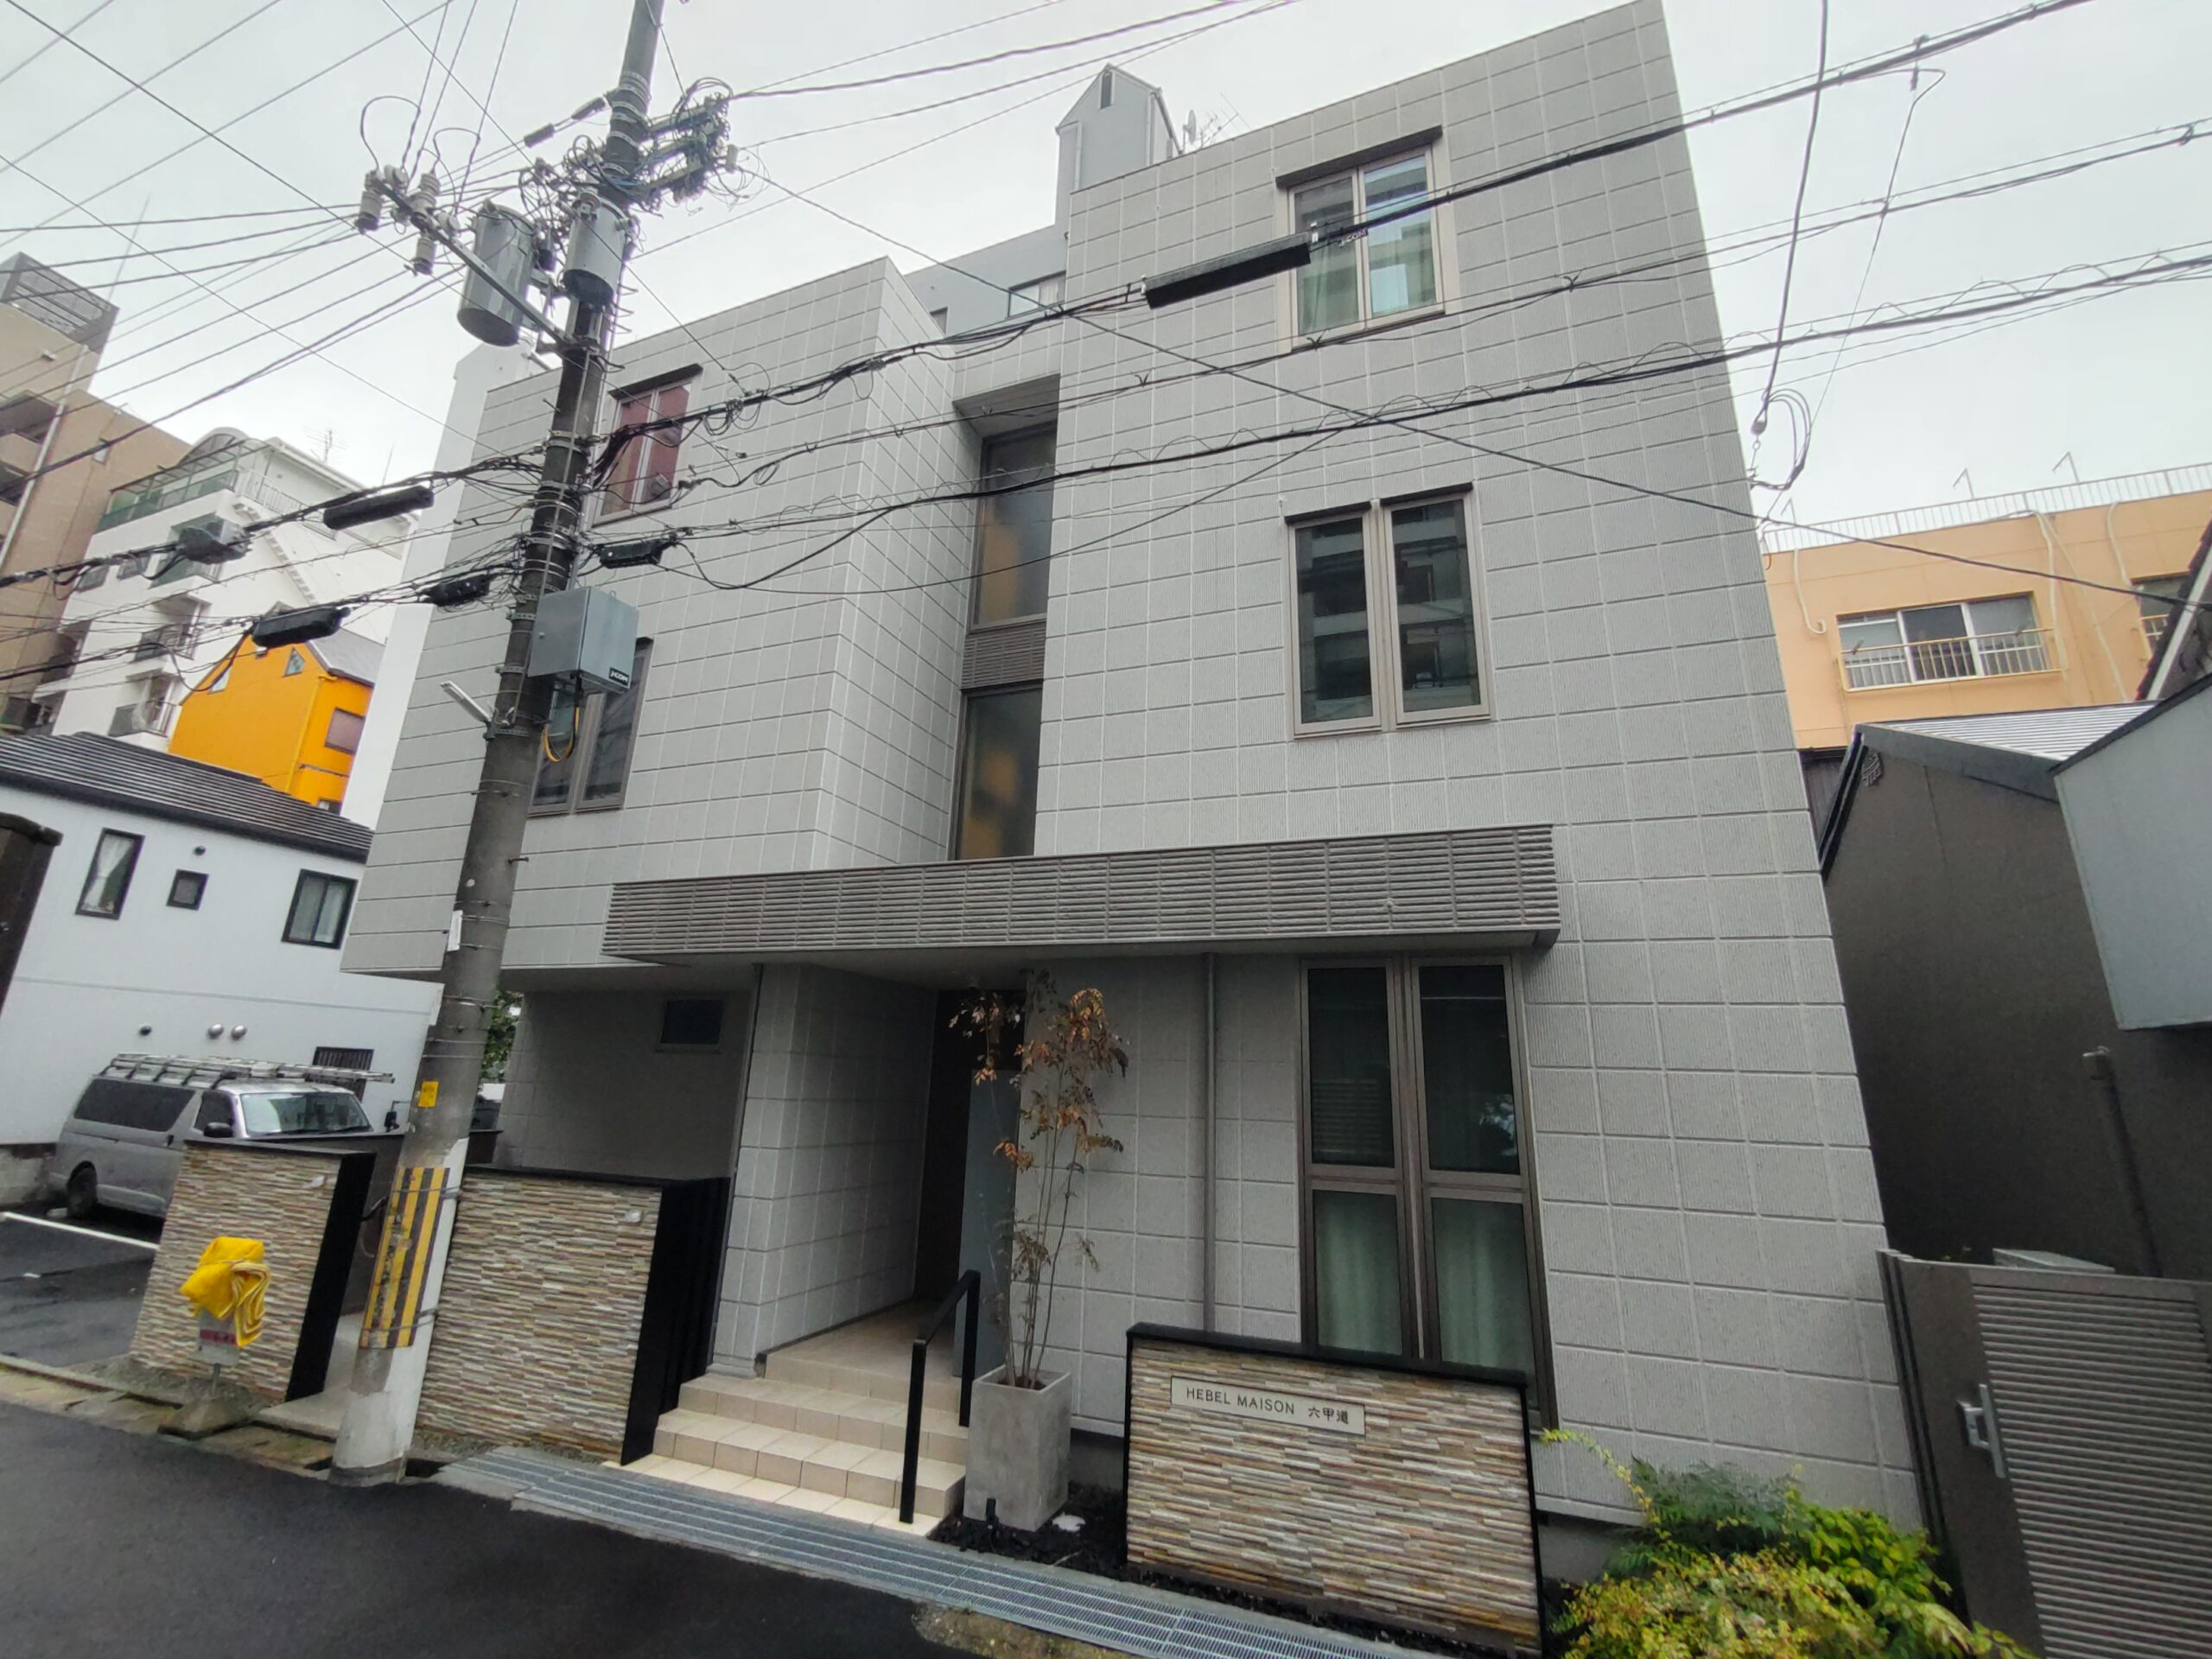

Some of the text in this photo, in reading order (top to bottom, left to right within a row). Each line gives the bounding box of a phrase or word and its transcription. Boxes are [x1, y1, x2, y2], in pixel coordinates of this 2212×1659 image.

[1186, 1386, 1349, 1424] HEBEL MAISON 六甲道
